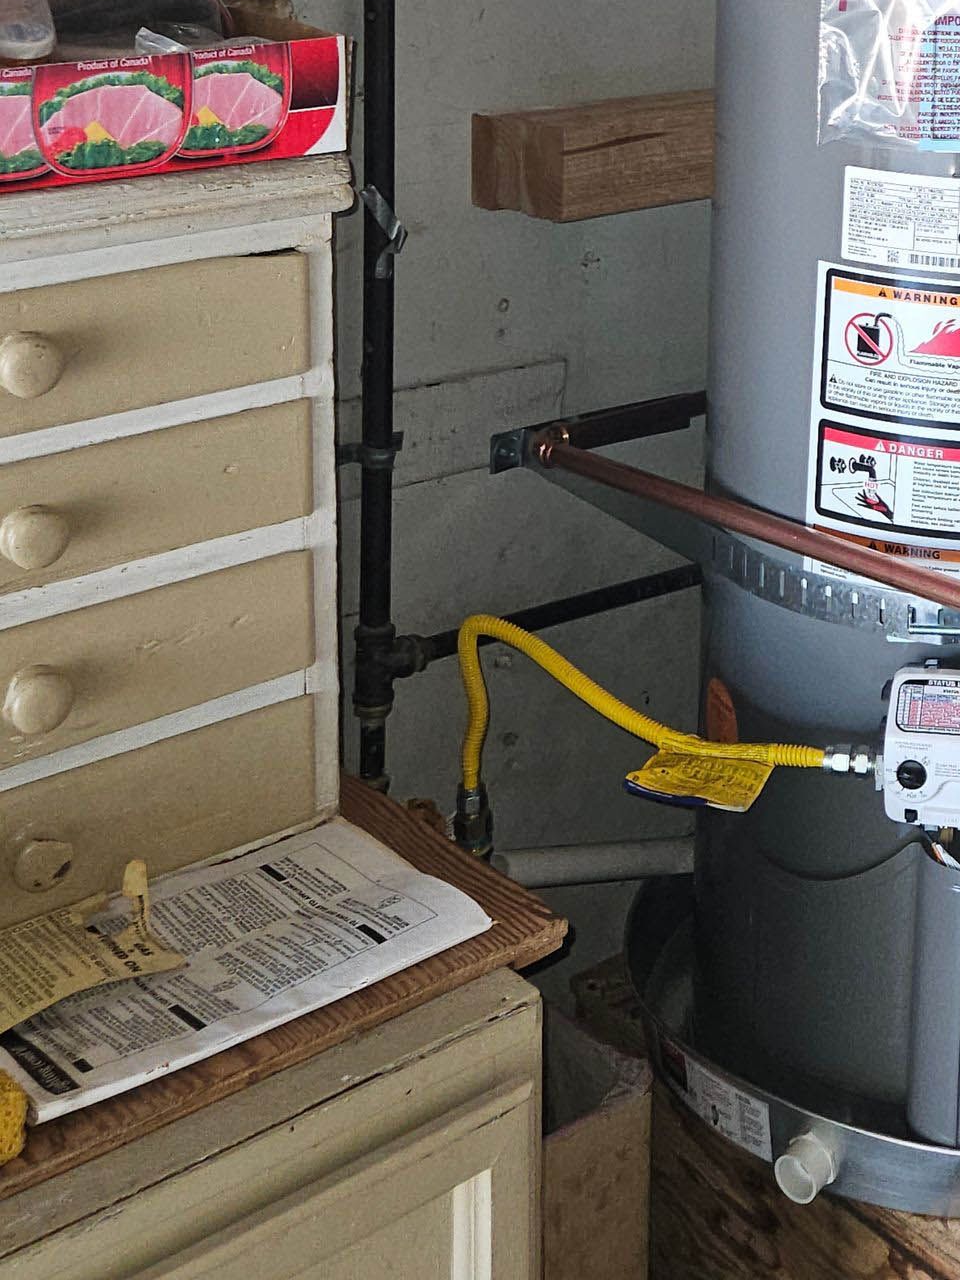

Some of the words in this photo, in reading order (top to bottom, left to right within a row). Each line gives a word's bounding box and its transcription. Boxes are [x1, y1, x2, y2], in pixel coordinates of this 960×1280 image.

[227, 47, 252, 56] Canada
[77, 60, 108, 71] Product
[120, 57, 148, 67] Canada
[893, 291, 959, 306] WARNING
[909, 358, 946, 368] Flammable
[870, 370, 882, 378] FIRE
[898, 375, 931, 384] EXPLOSION
[932, 379, 958, 387] HAZARD
[889, 443, 944, 459] DANGER
[864, 481, 879, 489] HOT
[884, 543, 941, 560] WARNING
